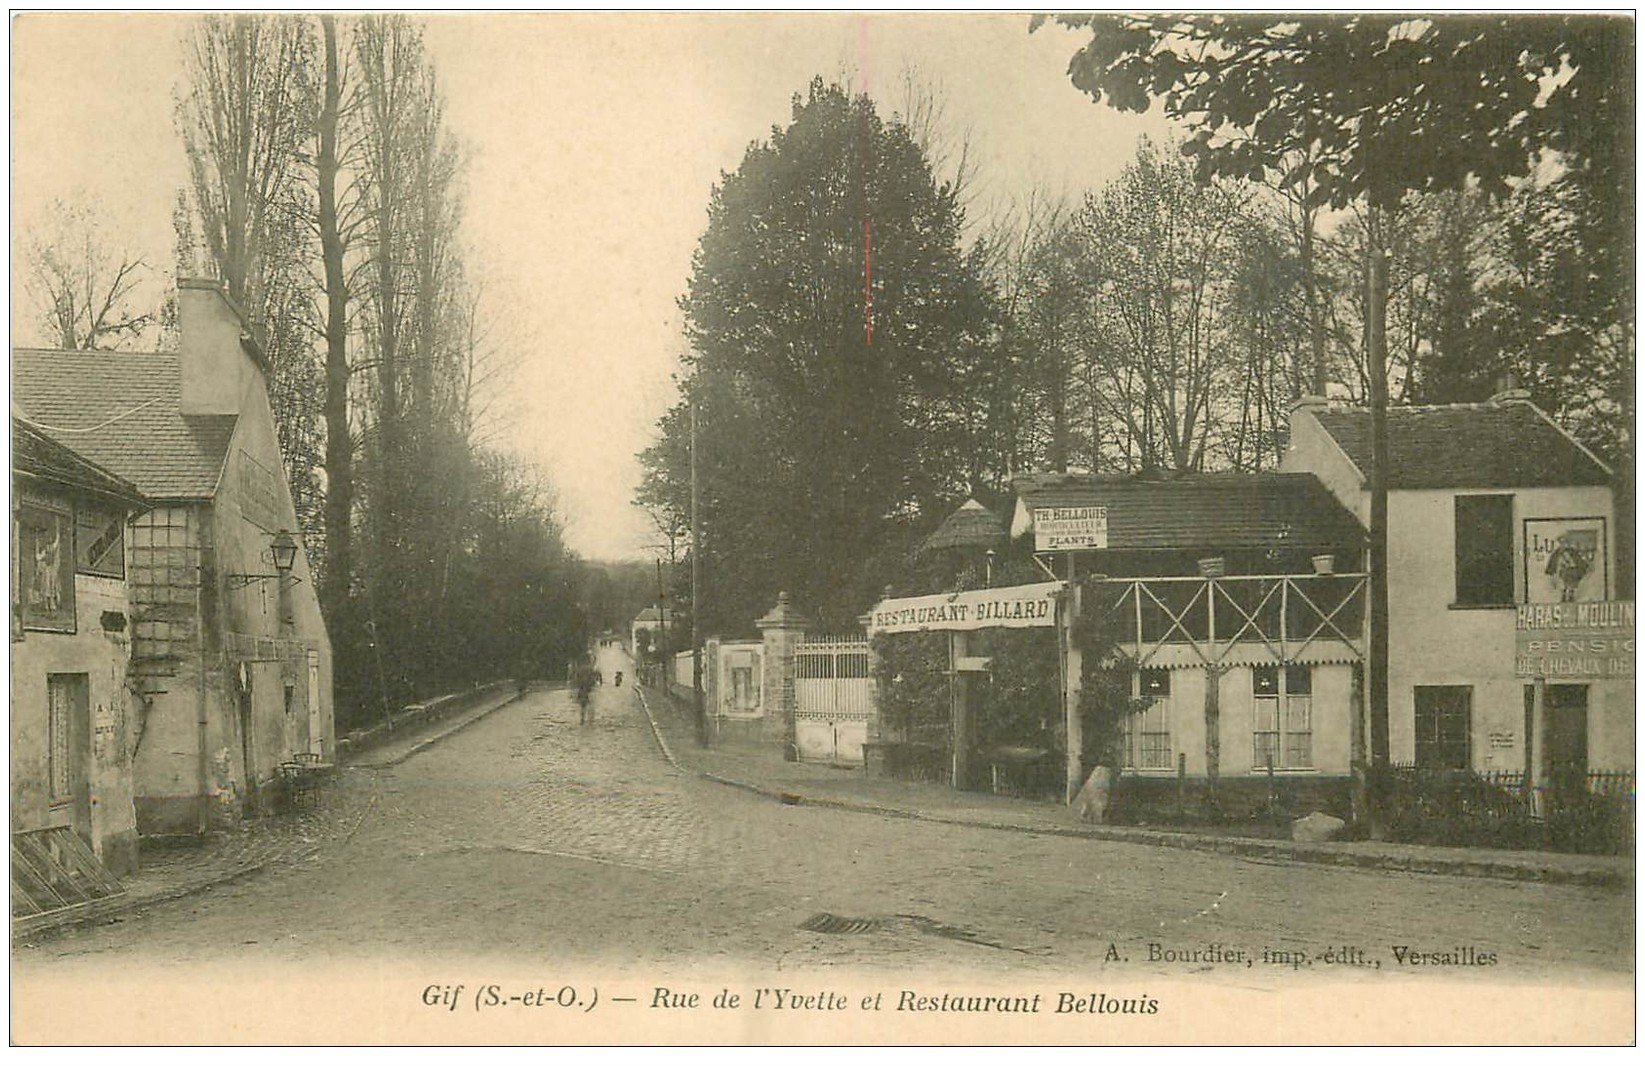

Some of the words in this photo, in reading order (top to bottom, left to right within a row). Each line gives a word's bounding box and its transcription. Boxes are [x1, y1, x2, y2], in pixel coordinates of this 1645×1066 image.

[1053, 508, 1107, 520] BELLOUIS
[1049, 536, 1094, 545] PLANTS
[876, 602, 969, 627] RESTAURANT
[977, 599, 1048, 622] BILLARD
[1517, 604, 1562, 629] HARAS
[1577, 602, 1635, 627] MOULIN
[1539, 656, 1601, 675] CHEVAUX
